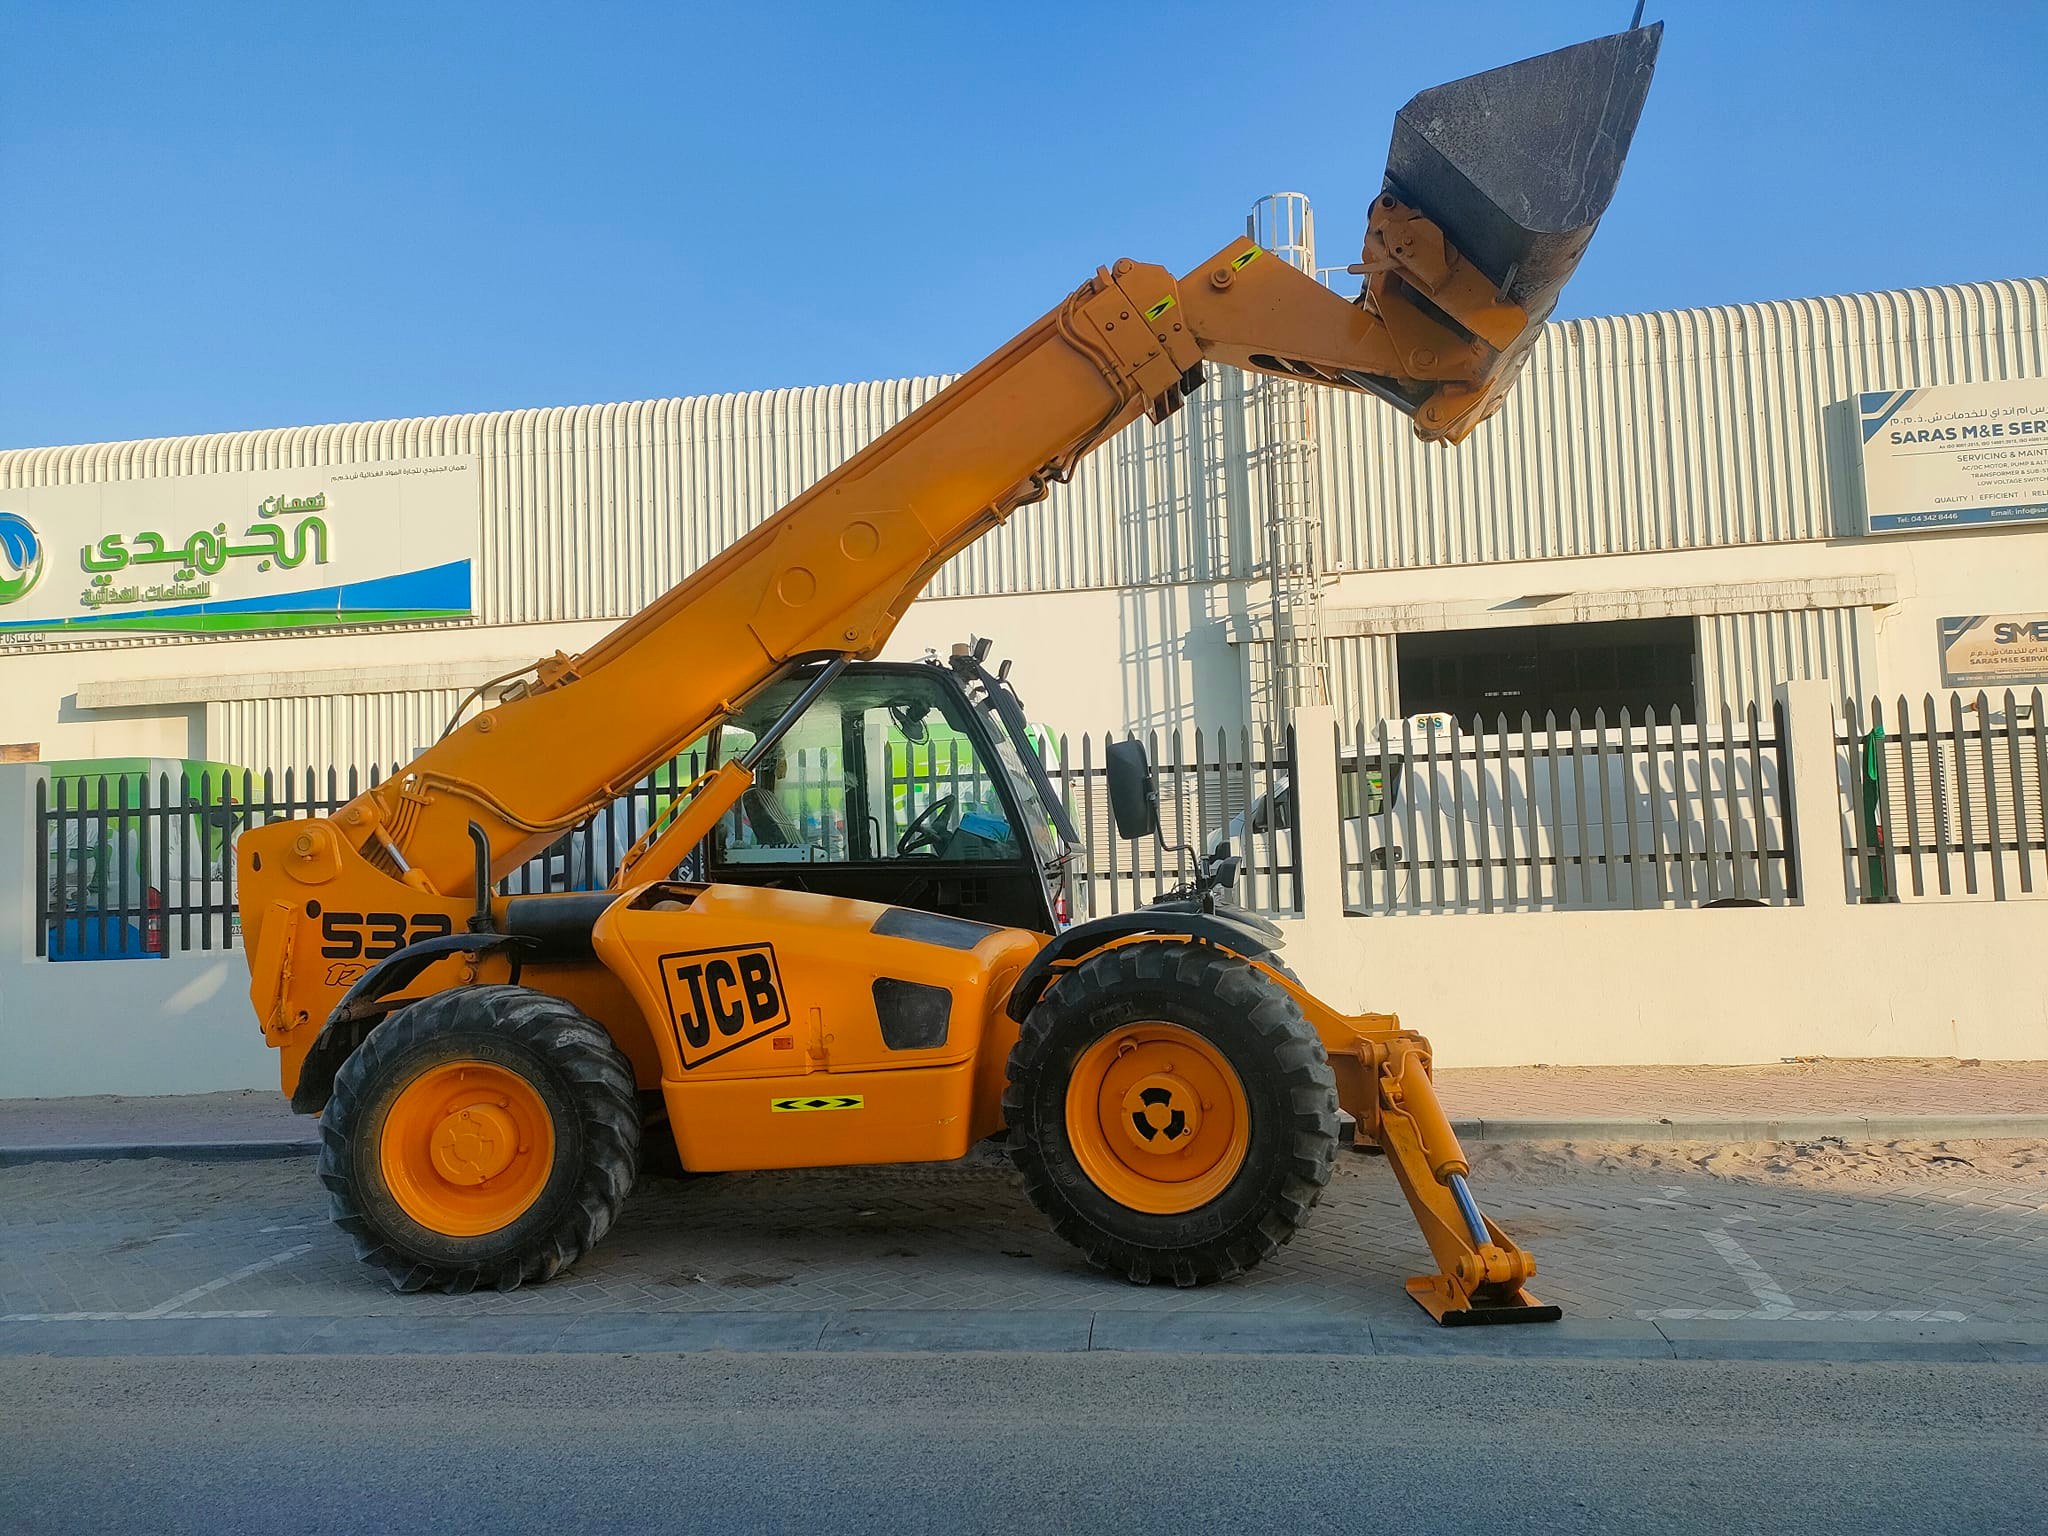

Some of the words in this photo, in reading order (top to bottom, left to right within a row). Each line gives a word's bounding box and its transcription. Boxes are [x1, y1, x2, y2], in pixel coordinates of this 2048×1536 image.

[1890, 427, 1957, 445] SARAS
[1962, 423, 2004, 440] M&E
[2008, 419, 2048, 436] SER
[1956, 451, 2007, 463] SERVICING
[1971, 470, 2020, 479] TRANSFORMER
[259, 492, 326, 518] نعمان
[1935, 495, 1968, 504] QUALITY
[1979, 492, 2018, 500] EFFICIENT
[1897, 515, 1910, 523] Tel:
[1911, 514, 1922, 522] 04
[1923, 514, 1937, 522] 342
[1938, 512, 1958, 521] 8446
[1991, 509, 2014, 517] Email:
[83, 516, 328, 585] الجنيدي
[1417, 716, 1442, 729] SS
[325, 962, 376, 986] 12
[676, 953, 780, 1049] JCB
